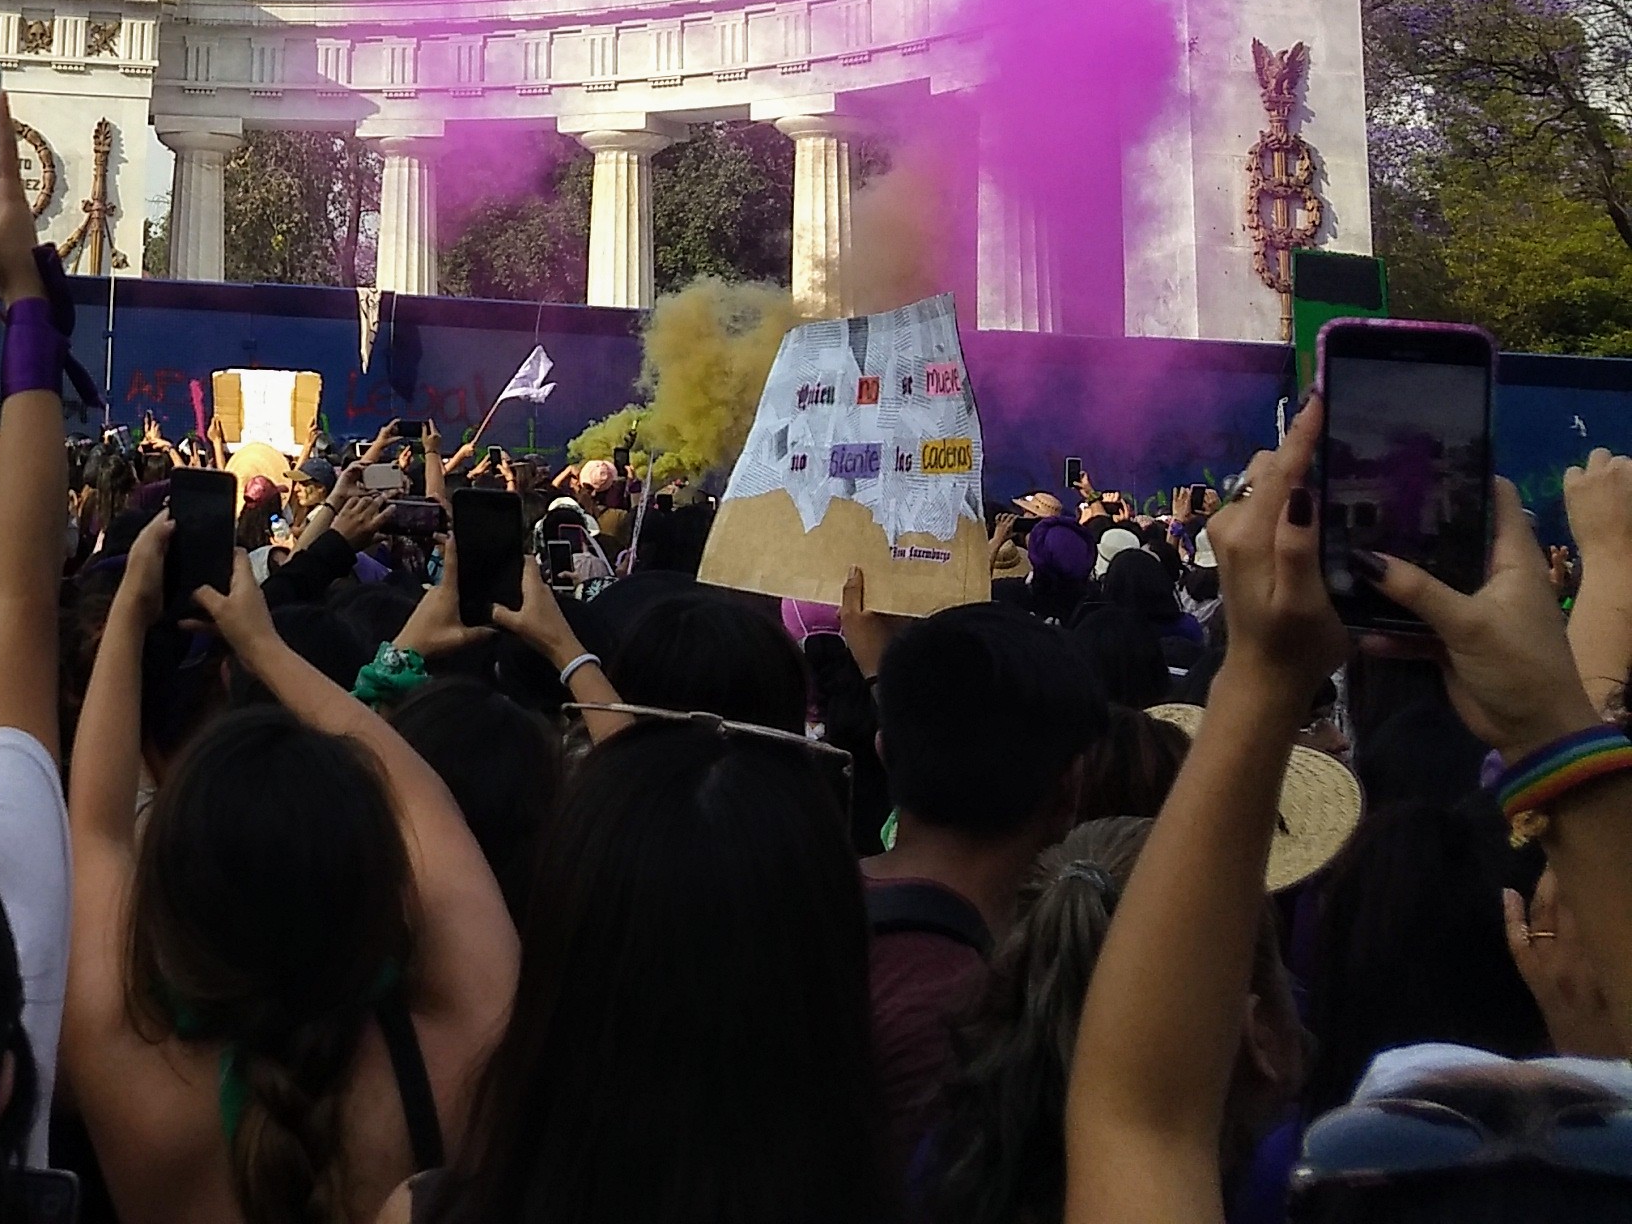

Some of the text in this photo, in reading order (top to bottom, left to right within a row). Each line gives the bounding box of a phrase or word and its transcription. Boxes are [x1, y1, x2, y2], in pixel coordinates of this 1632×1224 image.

[797, 380, 836, 410] Quien
[902, 376, 913, 395] se
[791, 453, 808, 471] no
[895, 446, 913, 472] las
